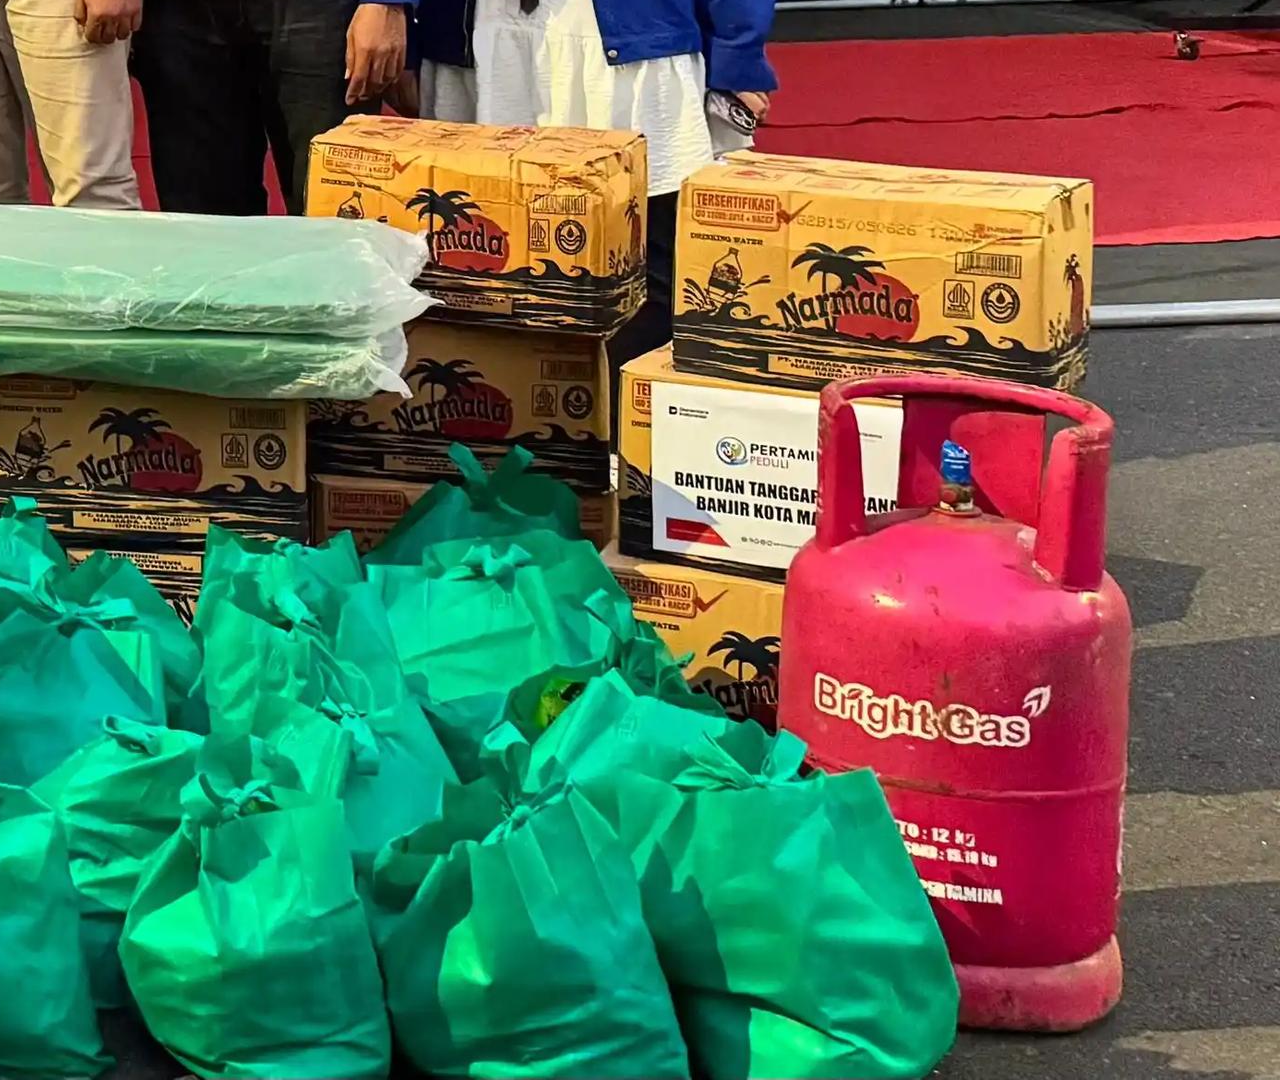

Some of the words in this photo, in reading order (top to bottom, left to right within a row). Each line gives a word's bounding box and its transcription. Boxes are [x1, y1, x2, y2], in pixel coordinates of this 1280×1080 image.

[695, 192, 775, 213] TERSERTIFIKASI
[732, 236, 765, 246] WATER
[776, 283, 915, 334] Narmada
[390, 390, 508, 436] Narmada
[749, 443, 818, 462] PERTAMI
[749, 456, 789, 470] PEDULI
[76, 440, 199, 491] Narmada
[674, 471, 745, 495] BANTUAN
[696, 496, 750, 517] BANJIR
[753, 503, 793, 523] KOTA
[814, 671, 939, 741] Bright
[940, 703, 1031, 748] Gas
[930, 827, 951, 844] 12
